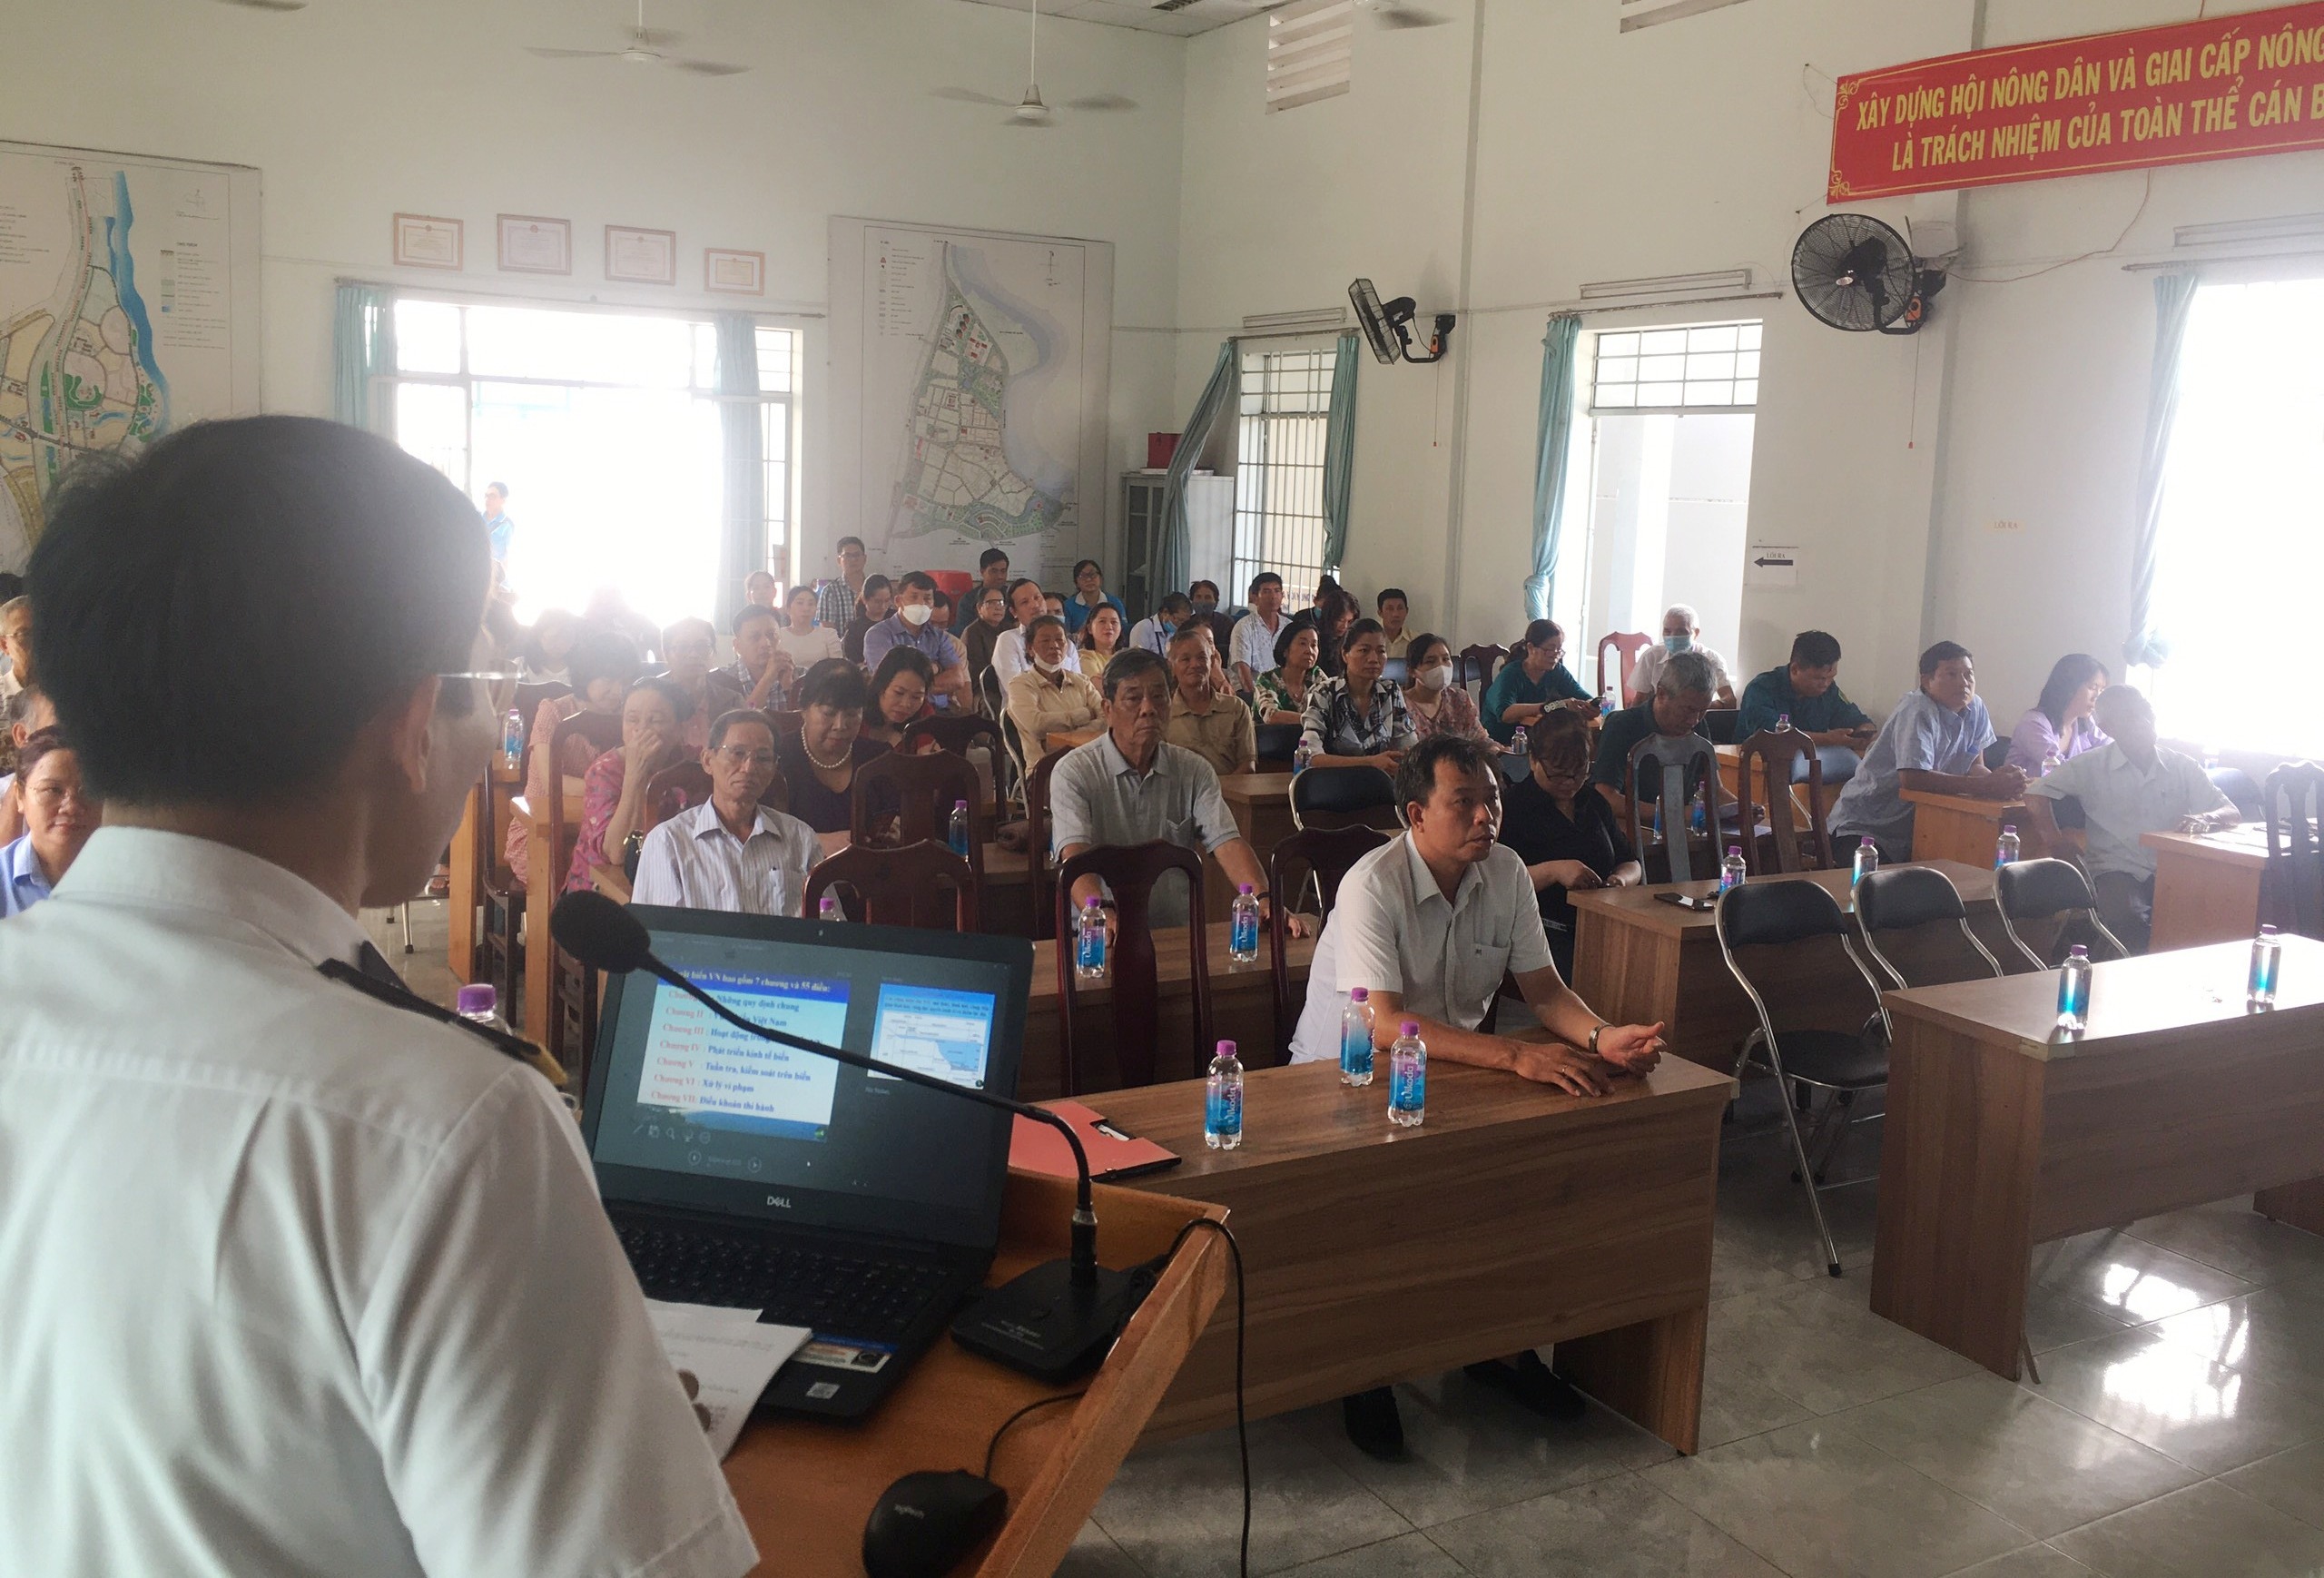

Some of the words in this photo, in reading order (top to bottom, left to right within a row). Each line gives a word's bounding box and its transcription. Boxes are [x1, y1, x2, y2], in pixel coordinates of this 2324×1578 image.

[1856, 92, 1891, 131] XÂY
[1895, 84, 1945, 128] DỰNG
[1949, 74, 1985, 120] HỘI
[1991, 66, 2049, 109] NÔNG
[2054, 56, 2101, 100] DÂN
[2108, 48, 2136, 92] VÀ
[2145, 46, 2192, 87] GIAI
[2200, 26, 2250, 79] CẤP
[2258, 22, 2324, 71] NÔNG
[1892, 132, 1914, 172] LÀ
[1921, 124, 1985, 167] TRÁCH
[1991, 113, 2062, 161] NHIỆM
[2067, 101, 2112, 150] CỦA
[2120, 96, 2183, 143] TOÀN
[2191, 75, 2244, 134] THỂ
[2249, 79, 2302, 128] CÁN
[1401, 1066, 1414, 1099] Vikoda
[1224, 1087, 1236, 1124] Vikoda
[766, 1195, 792, 1208] DELL
